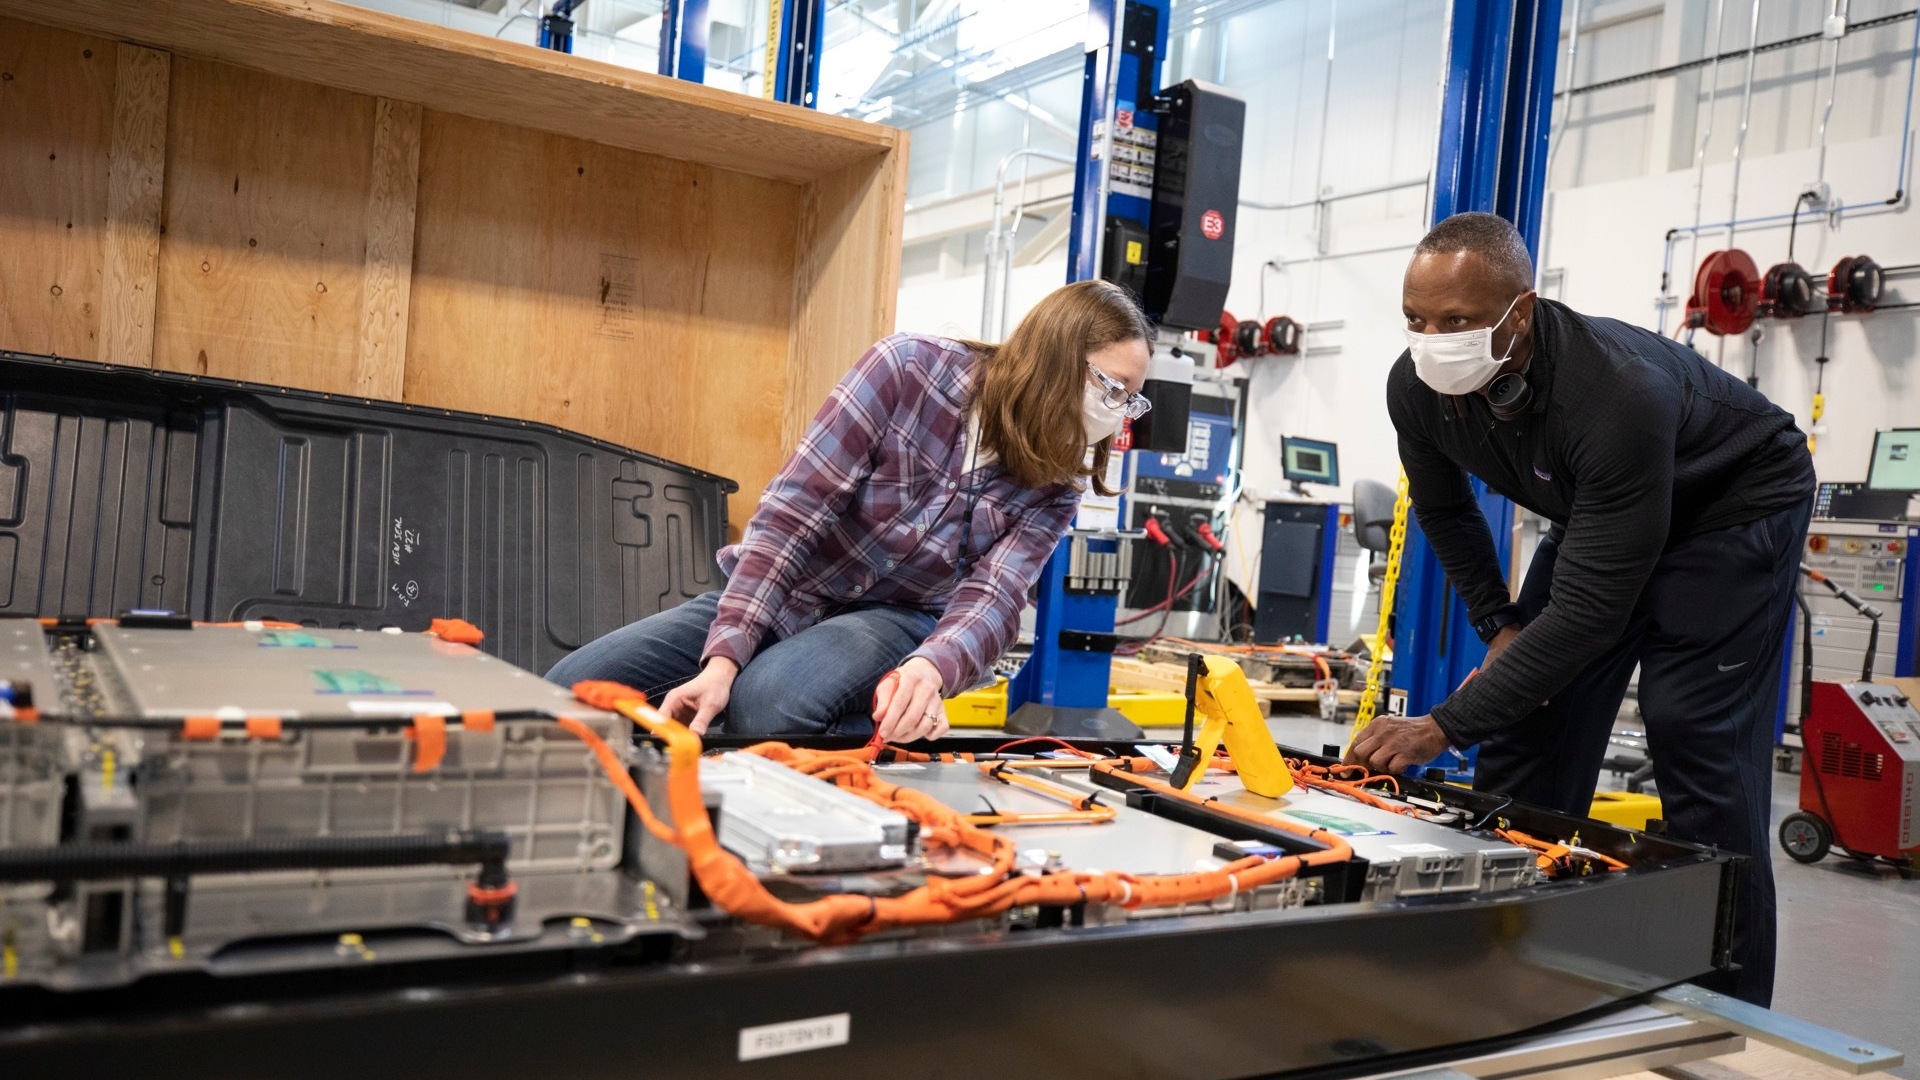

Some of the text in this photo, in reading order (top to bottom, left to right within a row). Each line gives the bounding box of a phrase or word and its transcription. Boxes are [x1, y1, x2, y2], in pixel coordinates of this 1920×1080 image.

[1204, 215, 1222, 234] E3
[391, 516, 403, 566] NEW SEAL
